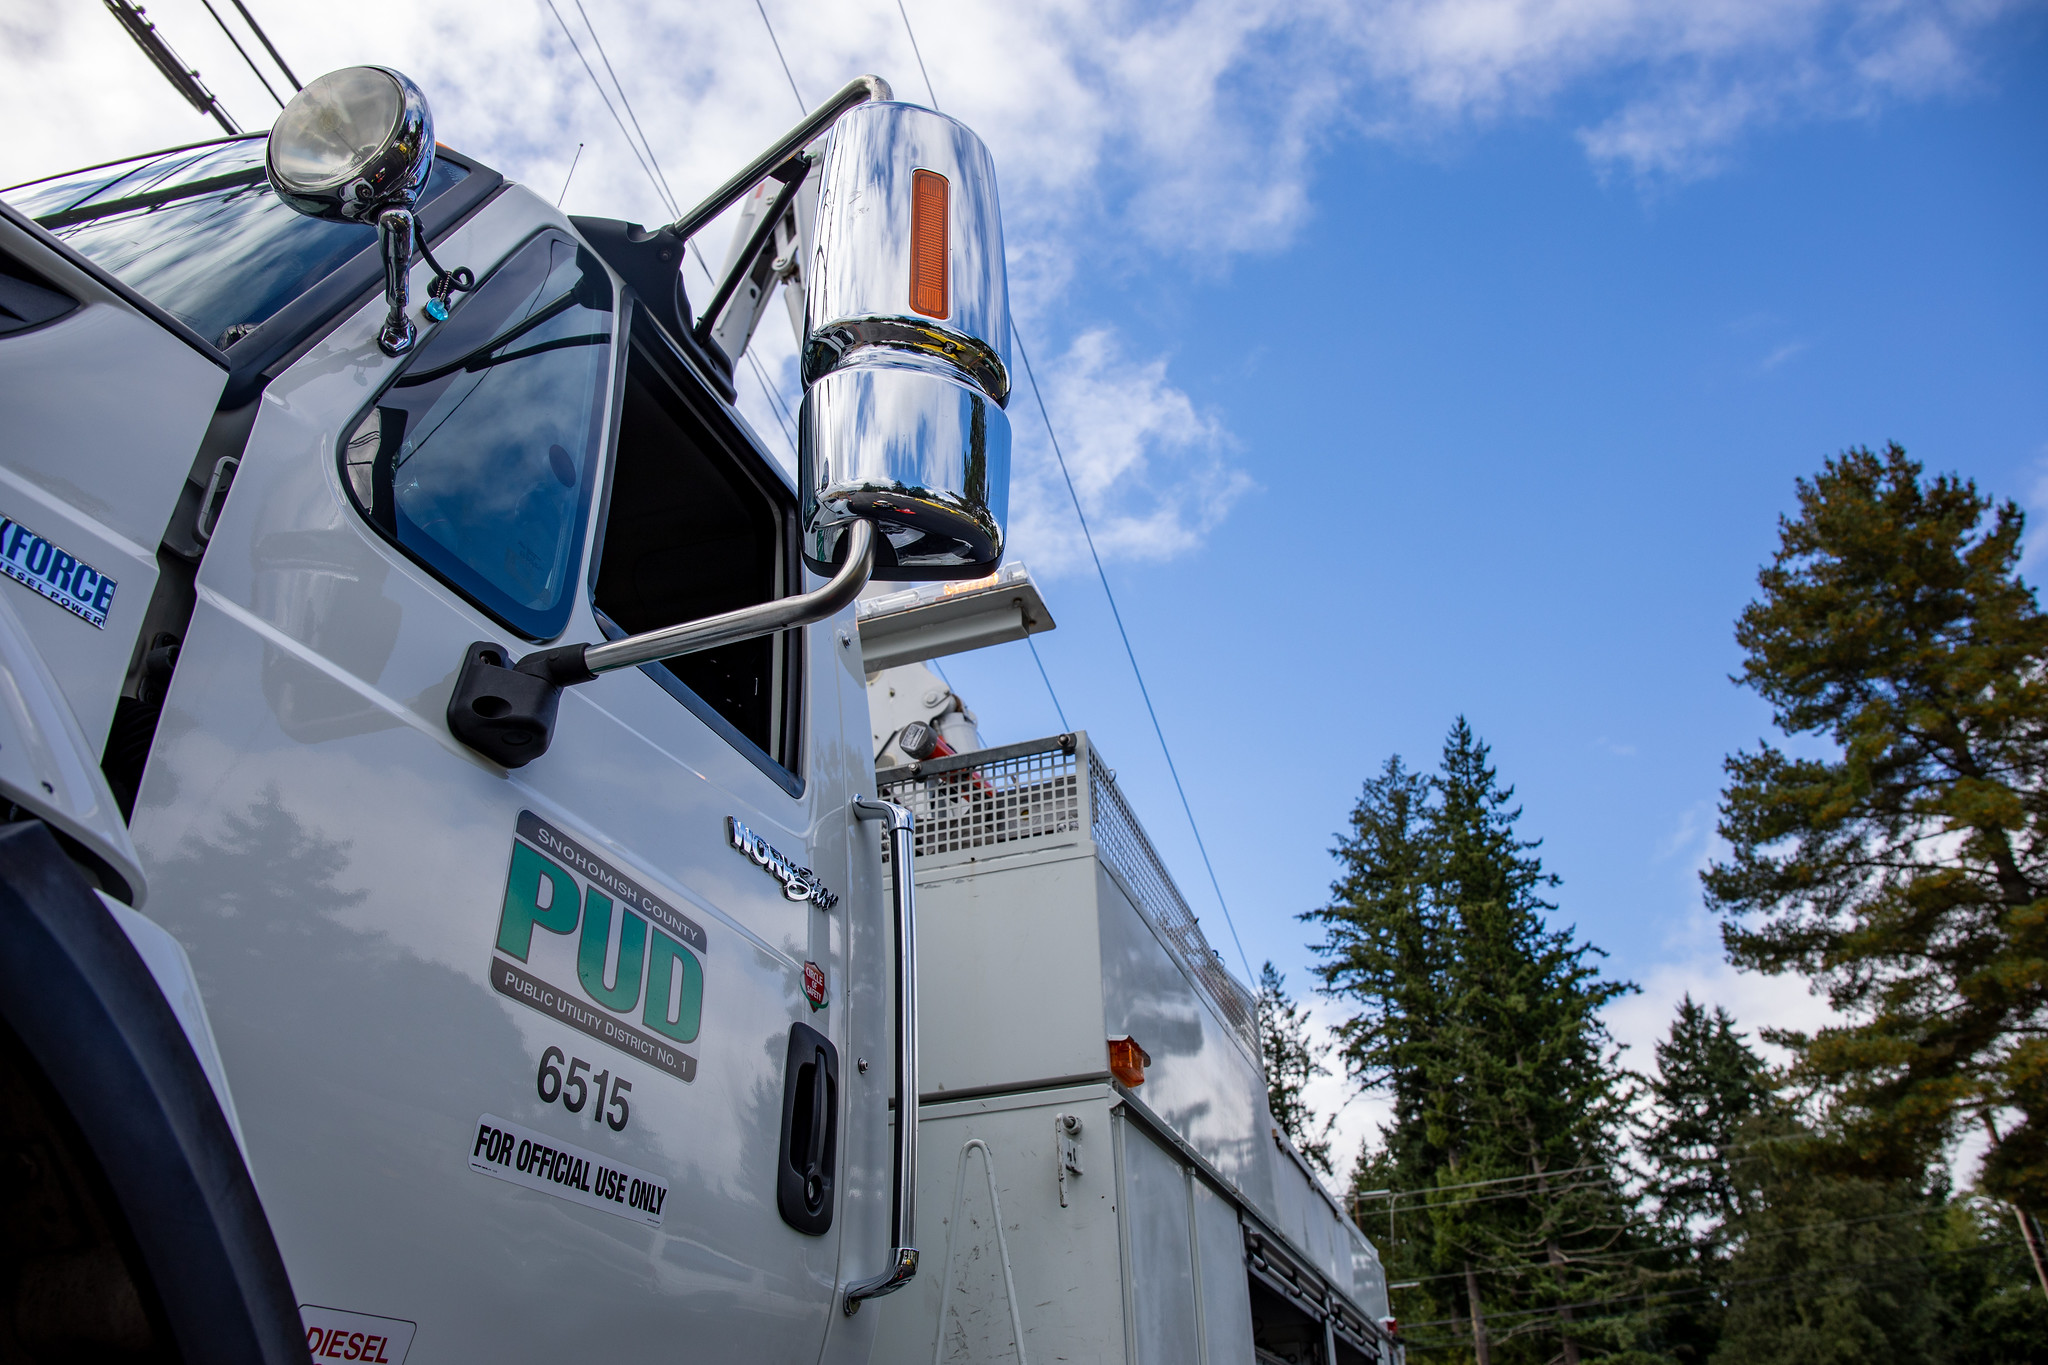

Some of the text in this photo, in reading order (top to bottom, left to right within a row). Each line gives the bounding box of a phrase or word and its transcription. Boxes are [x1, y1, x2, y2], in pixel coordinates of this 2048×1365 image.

[50, 591, 103, 625] POWER
[538, 828, 698, 941] SNOHOMISH COUNTY
[496, 838, 703, 1043] PUD
[805, 967, 823, 986] CIRCLE
[806, 984, 822, 1002] SAFETY
[811, 980, 818, 990] OF
[505, 971, 553, 1006] PUBLIC
[556, 997, 602, 1030] UTILITY
[605, 1021, 654, 1056] DISTRICT
[681, 1059, 687, 1073] 1
[537, 1045, 633, 1132] 6515
[473, 1124, 668, 1216] FOR OFFICIAL USE ONLY
[307, 1326, 388, 1363] DIESEL
